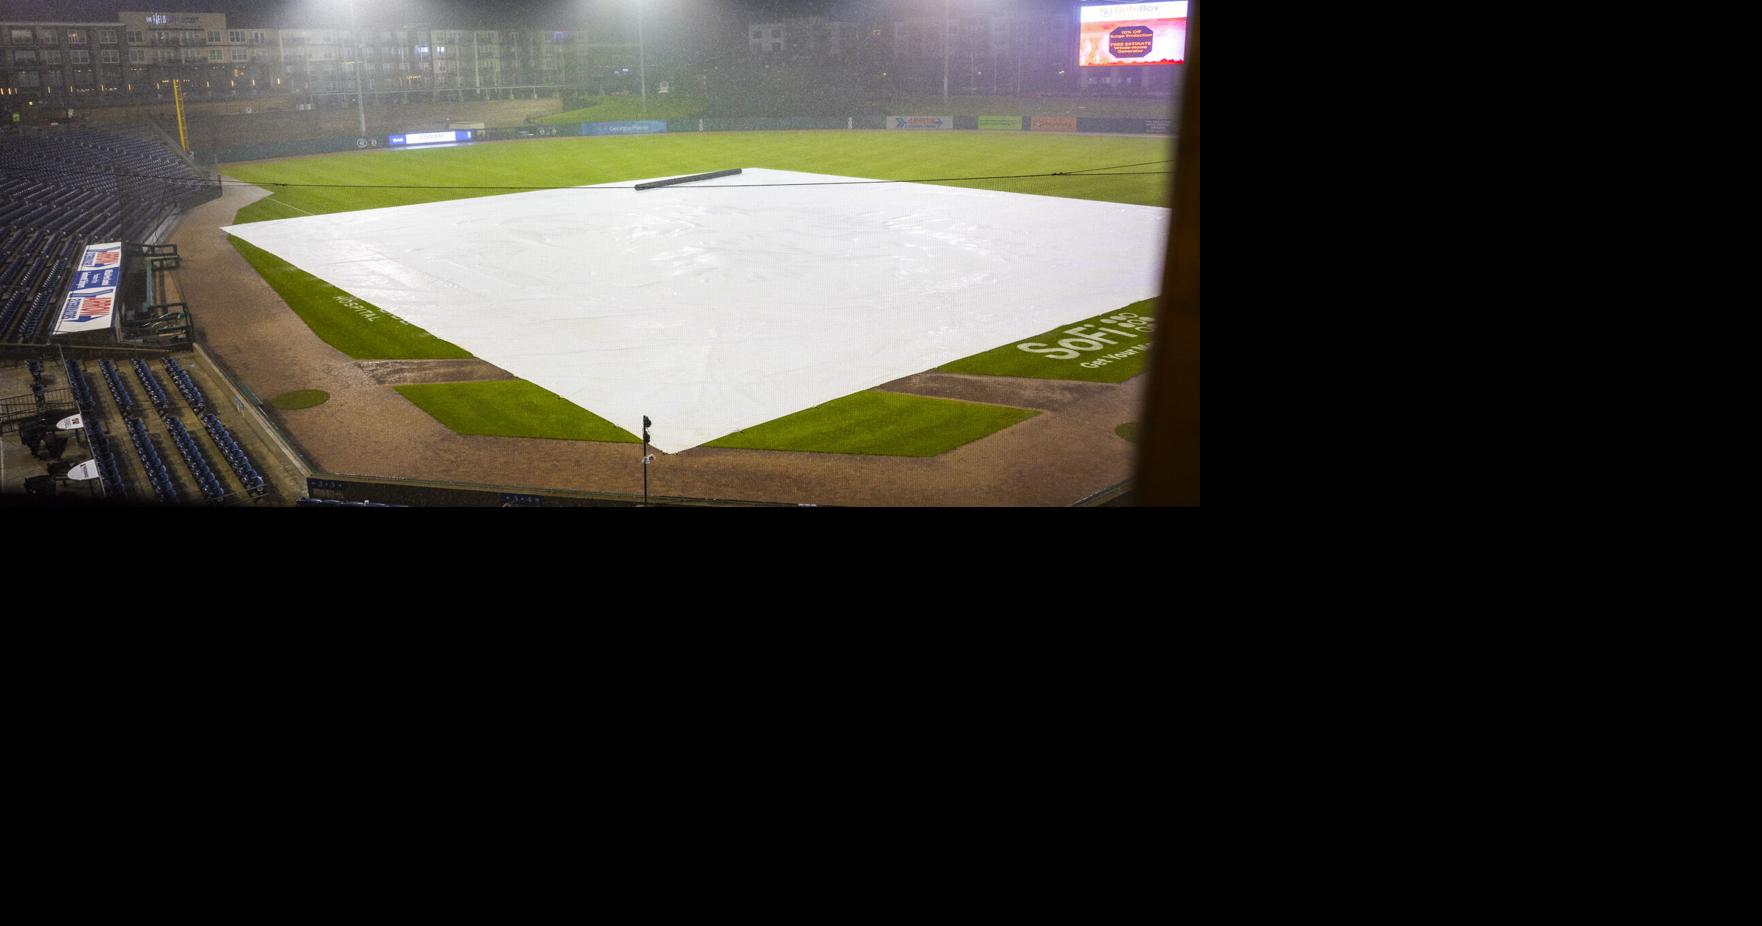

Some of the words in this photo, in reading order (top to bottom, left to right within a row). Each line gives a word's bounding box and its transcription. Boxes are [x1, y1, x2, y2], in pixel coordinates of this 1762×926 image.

[334, 295, 381, 322] HOSPITAL
[1016, 322, 1138, 360] SoFi
[1080, 358, 1113, 369] Get
[1102, 349, 1139, 360] Your
